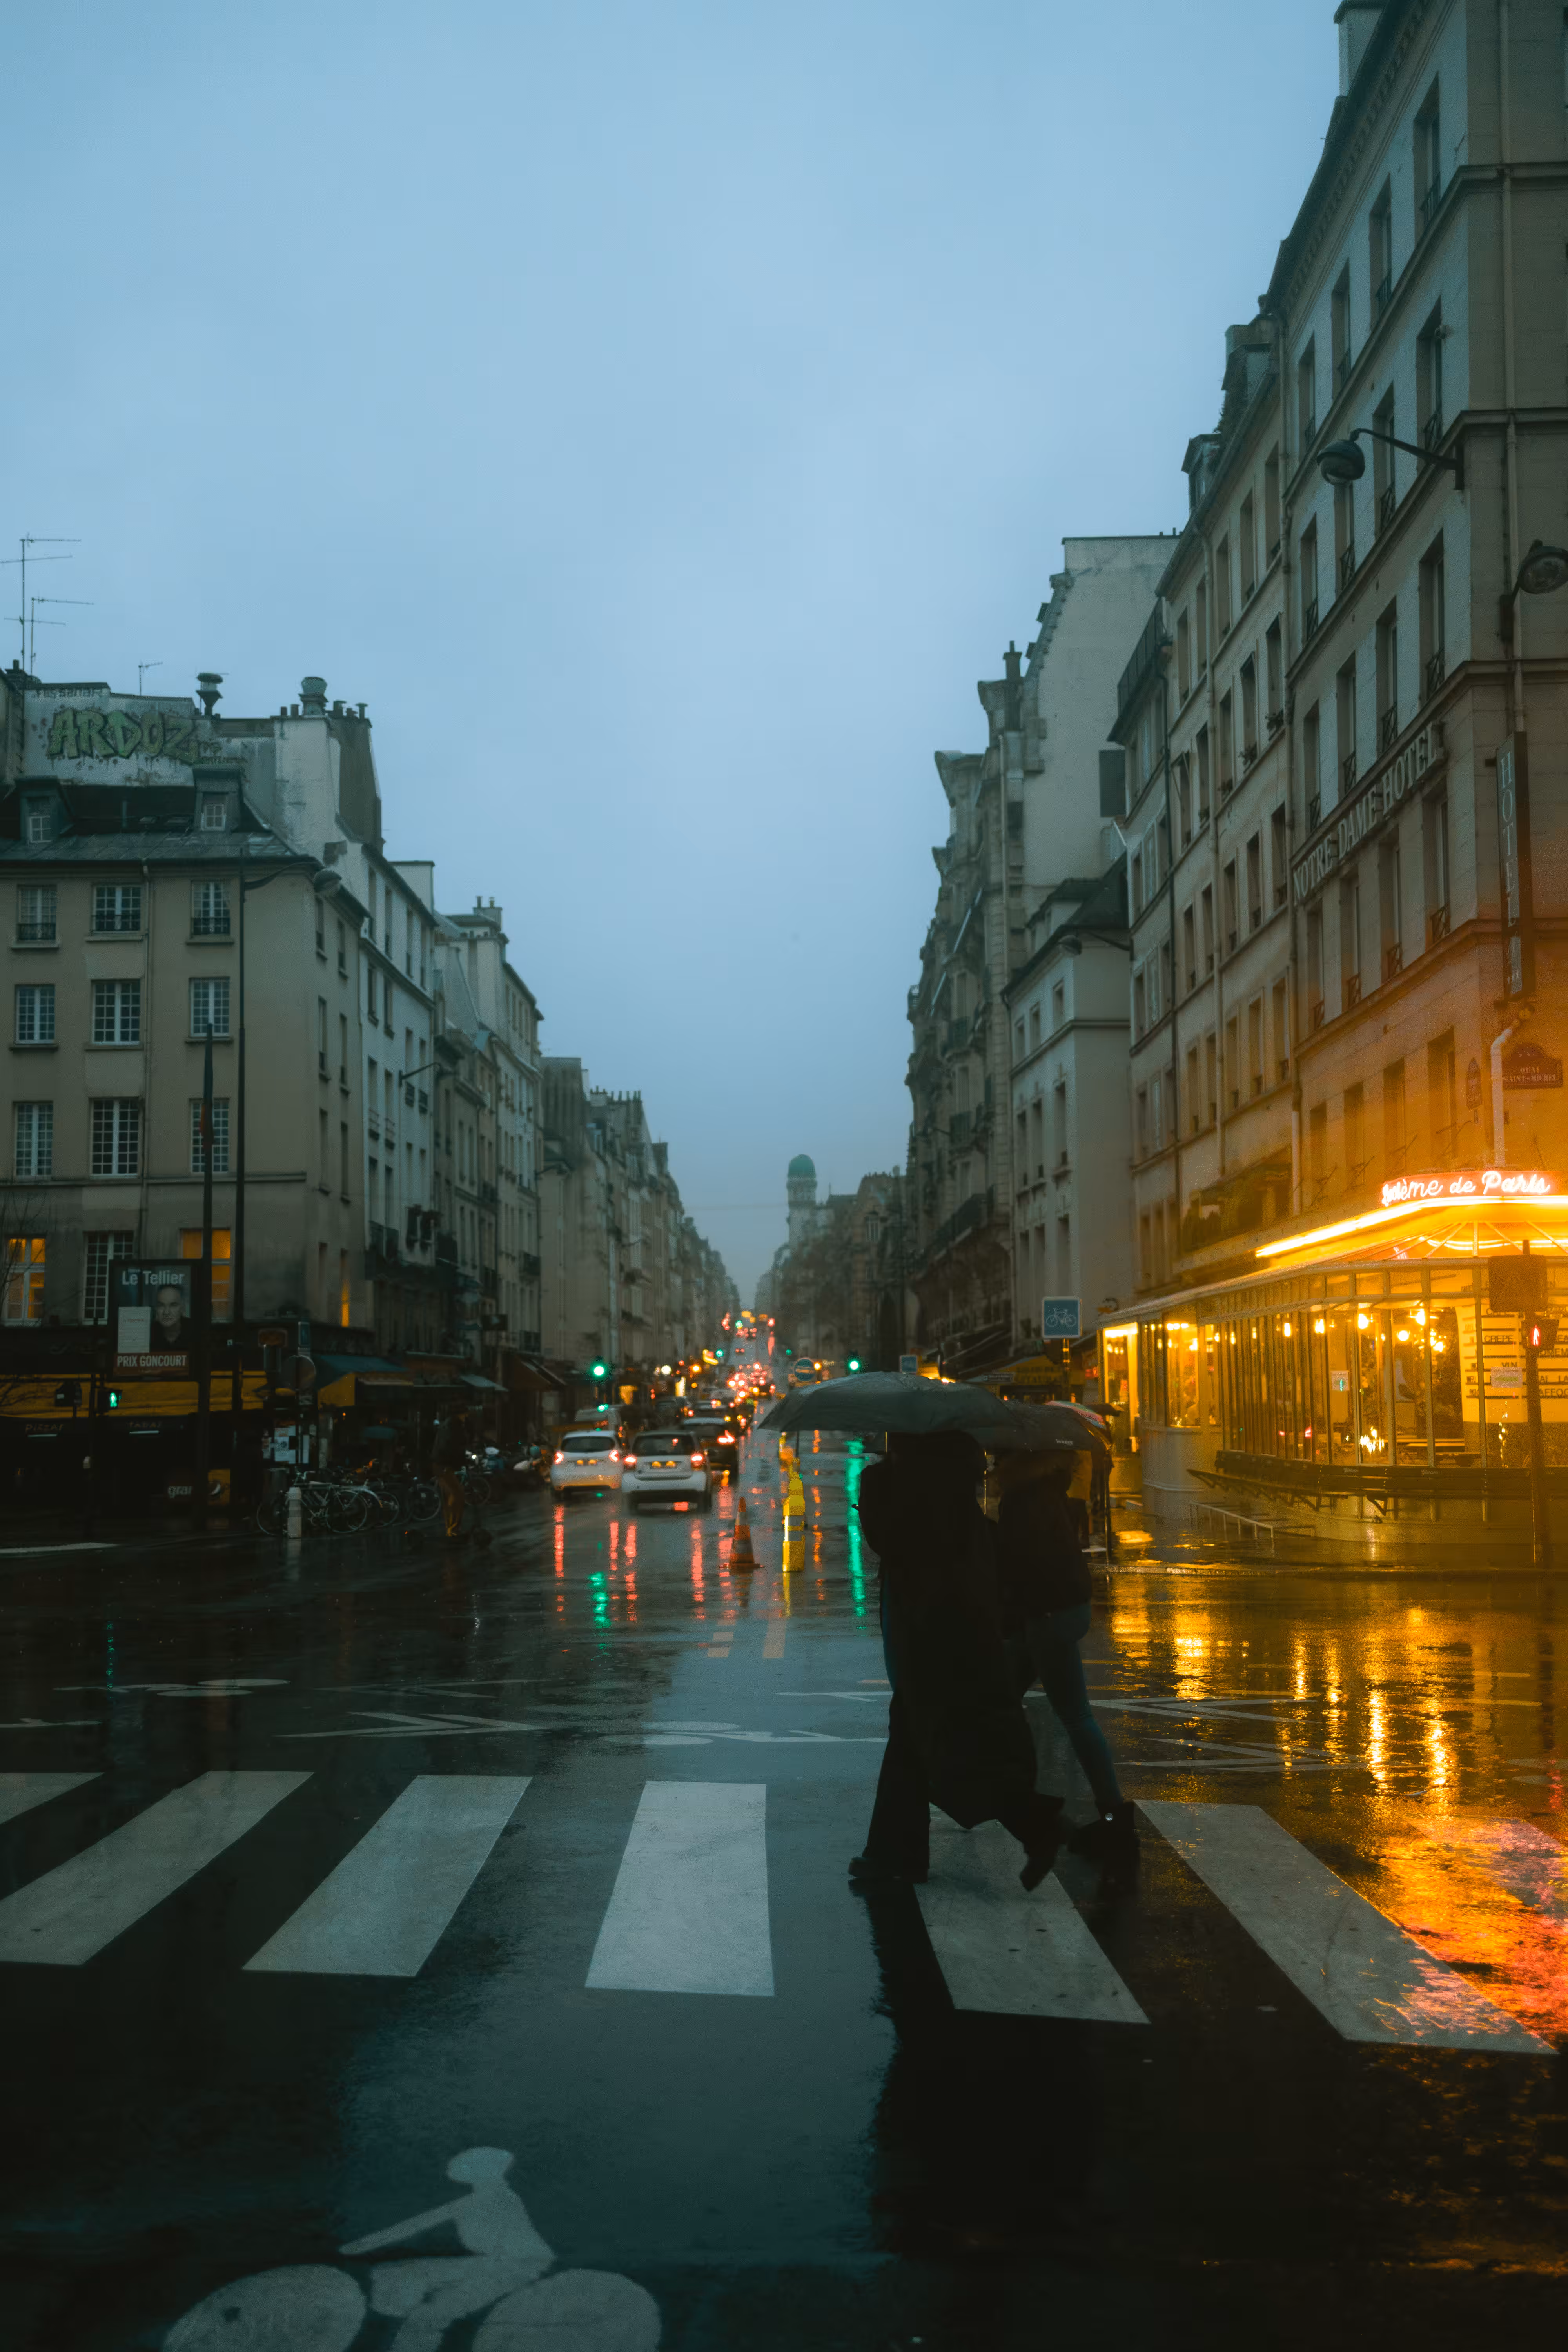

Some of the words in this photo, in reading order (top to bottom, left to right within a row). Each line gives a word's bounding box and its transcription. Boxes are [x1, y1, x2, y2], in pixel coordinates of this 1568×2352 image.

[1293, 837, 1333, 899] NOTRE
[1338, 786, 1377, 858] DAME
[1381, 721, 1443, 815] HOTEL
[1501, 751, 1517, 928] HOTEL
[1505, 1074, 1557, 1082] SAINT-MICHEL
[1449, 1176, 1477, 1194] de
[1481, 1170, 1551, 1195] Paris
[122, 1270, 138, 1285] Le
[142, 1270, 185, 1285] Tellier
[117, 1355, 138, 1367] PRIX
[139, 1355, 187, 1367] GONCOURT
